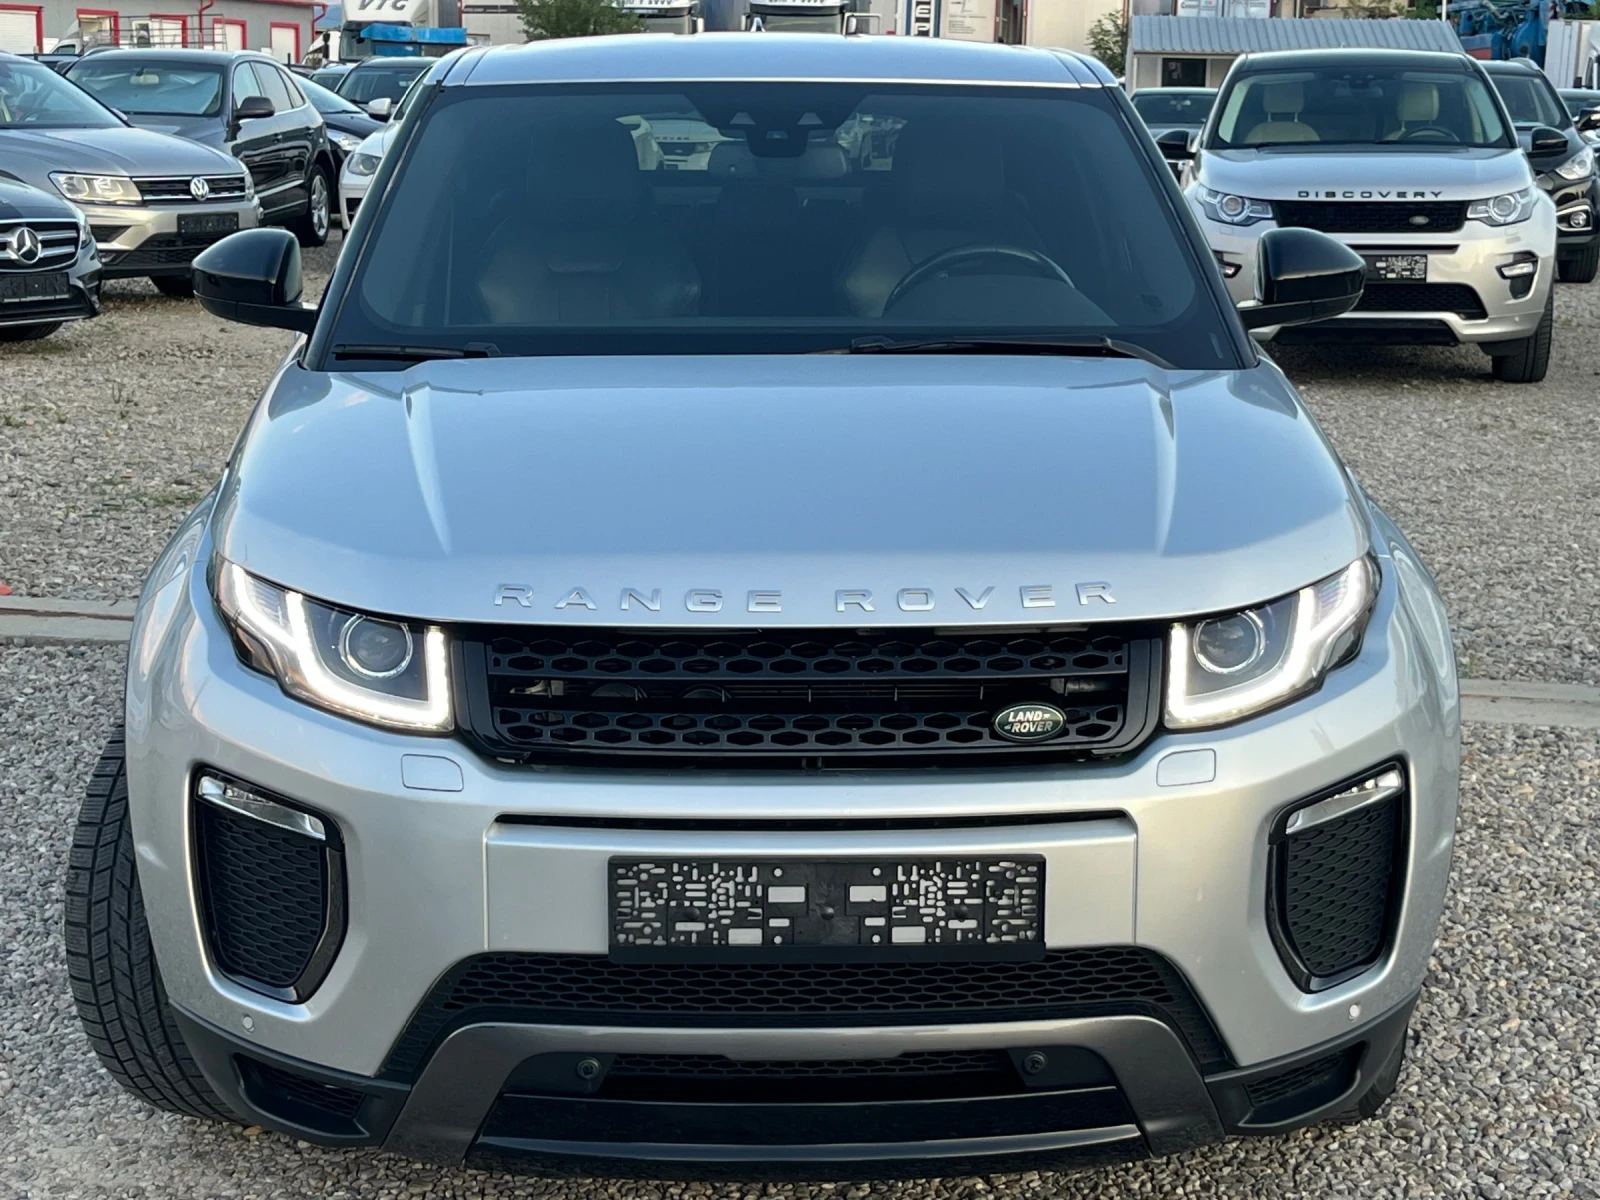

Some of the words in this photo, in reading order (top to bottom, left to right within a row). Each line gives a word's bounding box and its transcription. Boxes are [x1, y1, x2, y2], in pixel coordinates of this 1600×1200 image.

[1298, 190, 1443, 199] DISCOVERY
[494, 583, 782, 613] RANGE
[835, 580, 1117, 612] ROVER
[1008, 711, 1043, 723] LAND
[1011, 721, 1053, 733] ROVER
